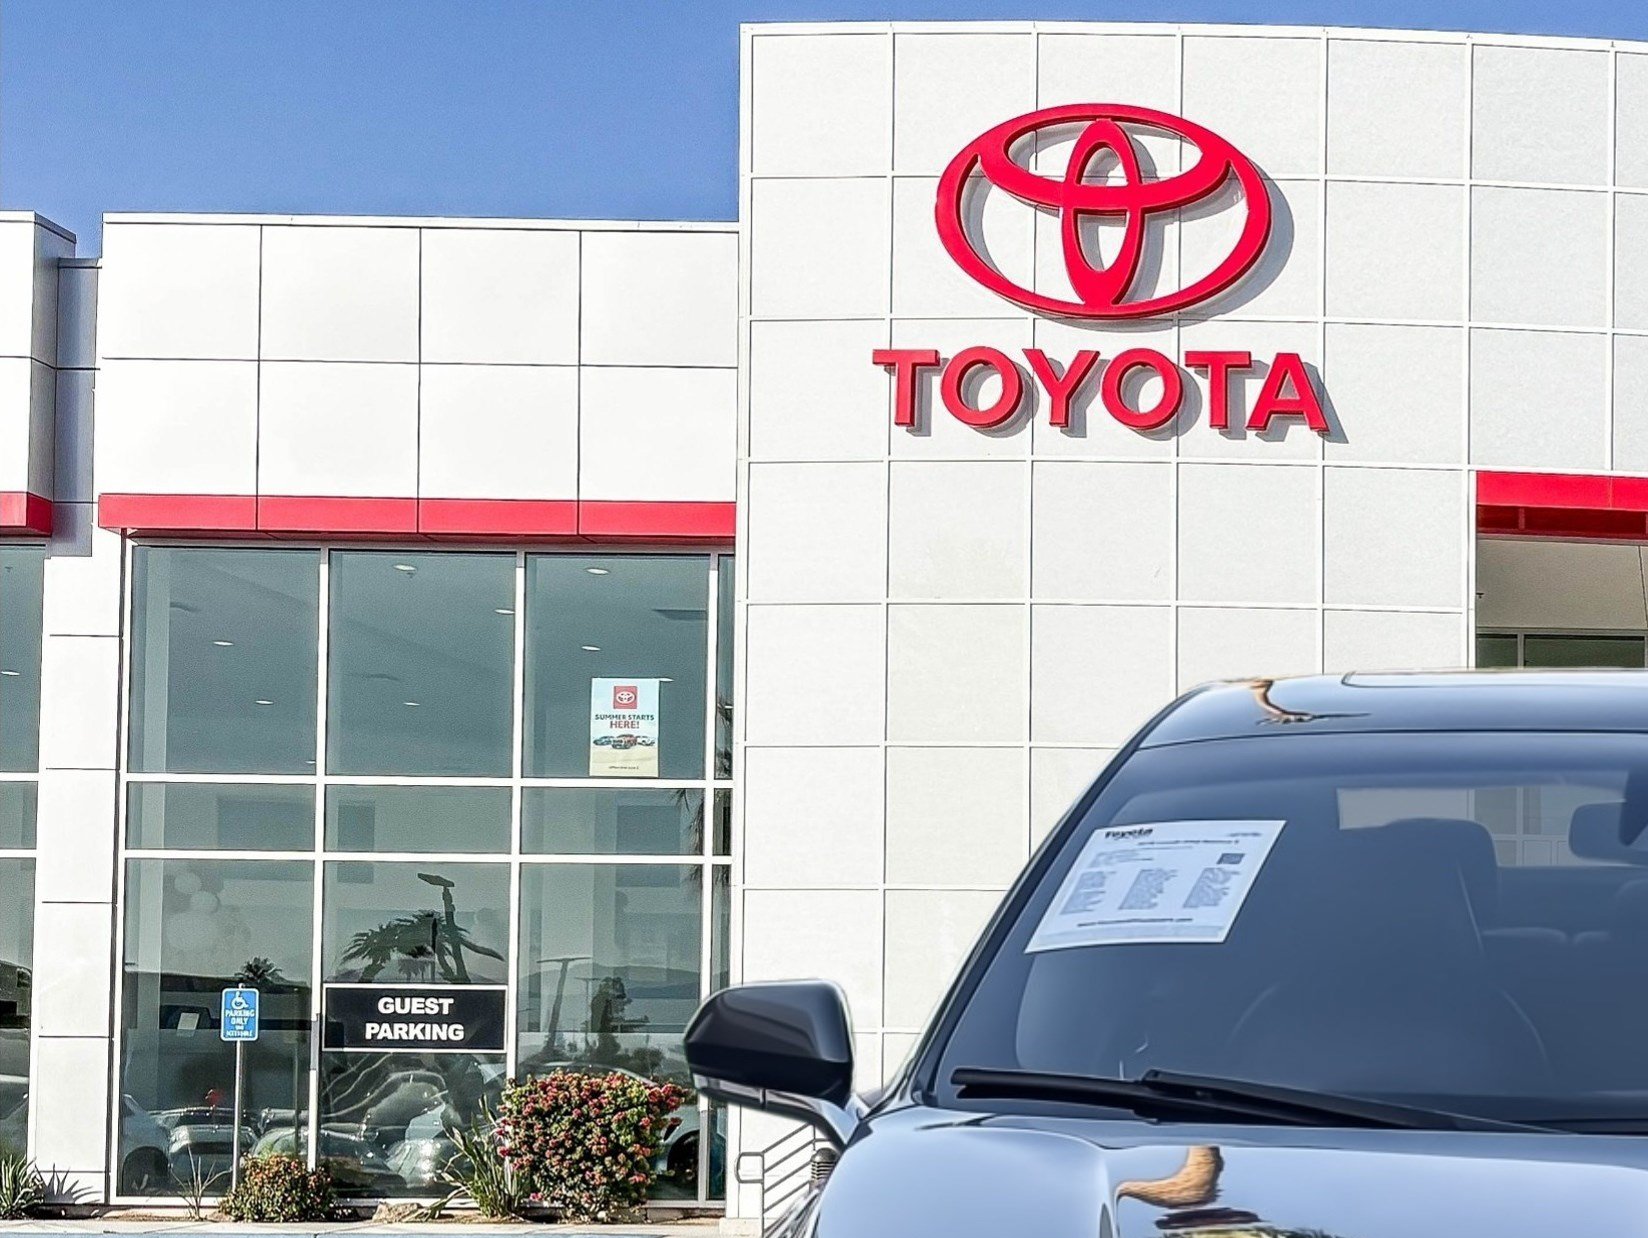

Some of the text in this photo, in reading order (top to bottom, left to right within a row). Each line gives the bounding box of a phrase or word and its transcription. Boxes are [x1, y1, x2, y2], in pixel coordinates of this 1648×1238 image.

[873, 346, 1329, 432] TOYOTA
[609, 720, 640, 729] HERE!
[378, 997, 454, 1015] GUEST
[225, 1009, 255, 1017] PARKING
[230, 1017, 249, 1025] ONLY
[365, 1023, 465, 1041] PARKING
